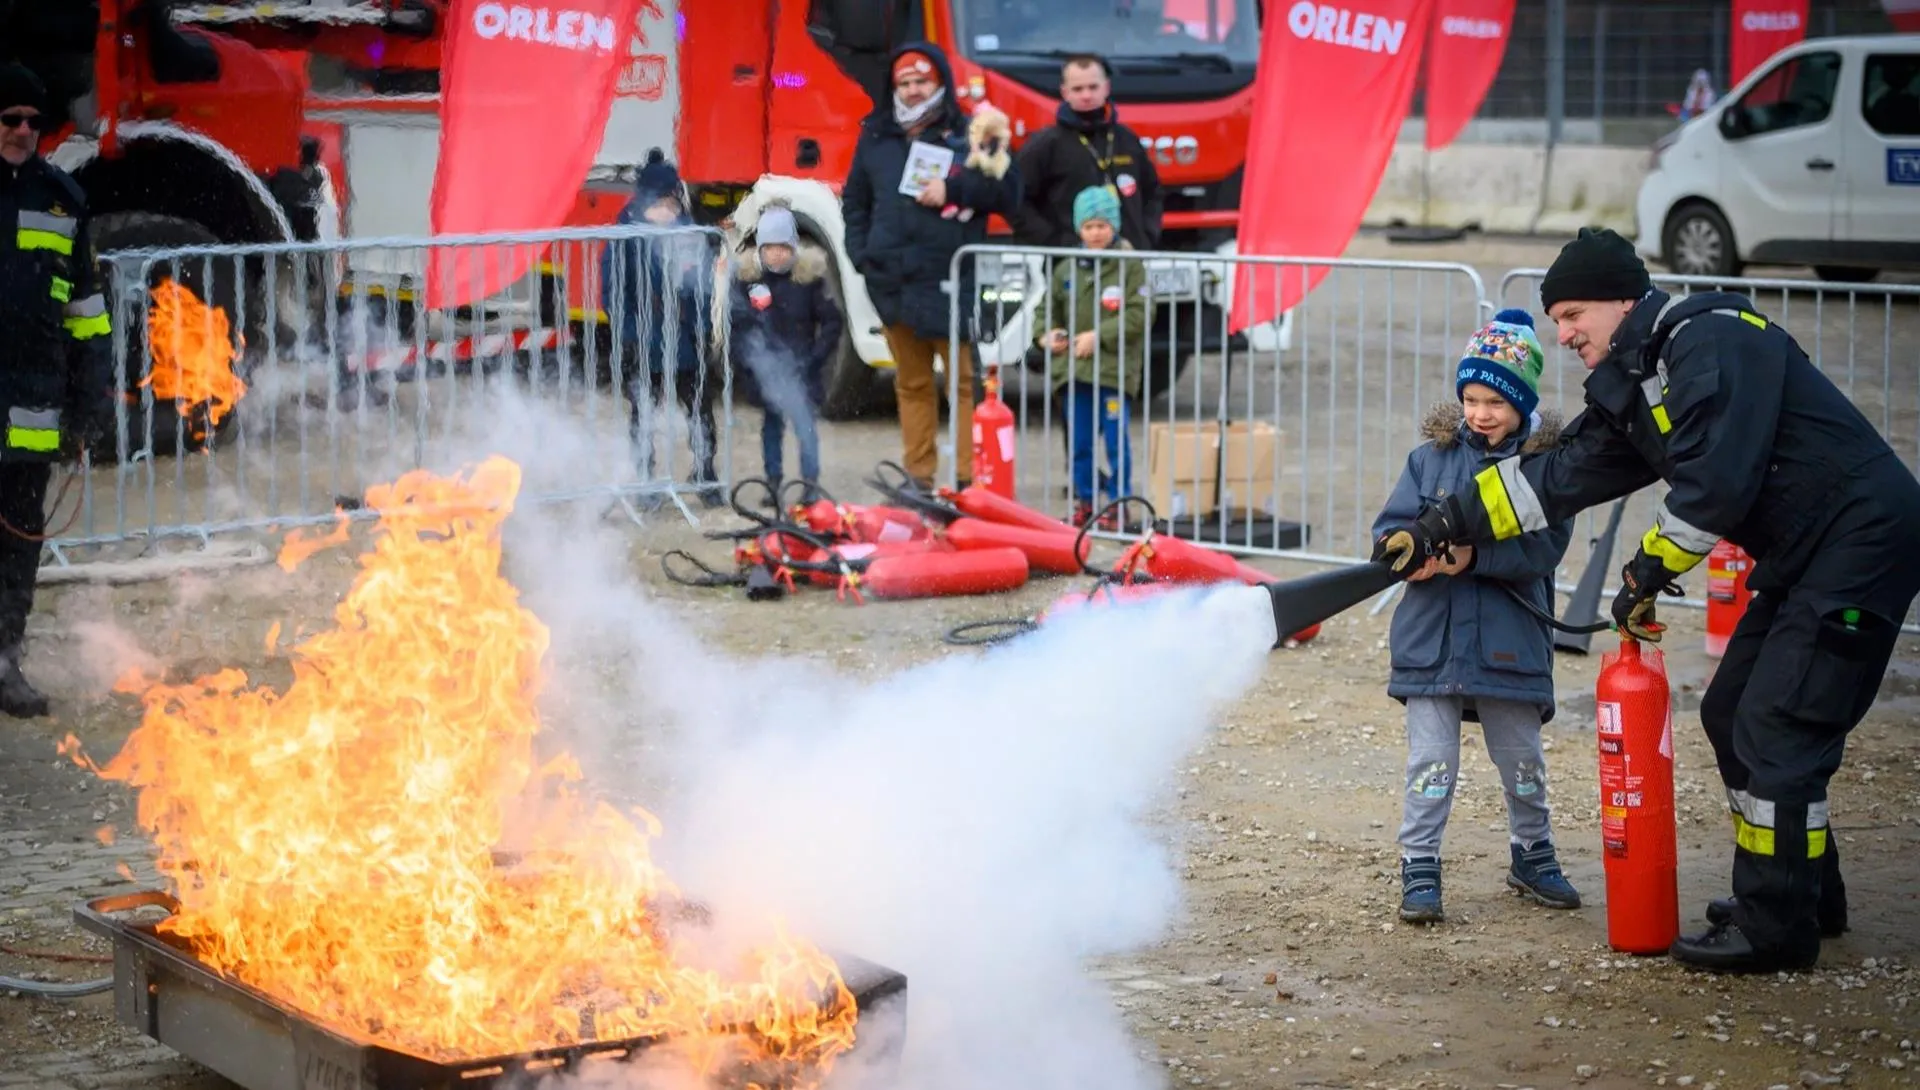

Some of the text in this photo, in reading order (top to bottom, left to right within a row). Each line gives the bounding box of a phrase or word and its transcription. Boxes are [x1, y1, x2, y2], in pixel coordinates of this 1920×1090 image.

[474, 4, 616, 50] ORLEN
[1287, 0, 1406, 55] ORLEN
[1442, 16, 1502, 38] ORLEN
[1742, 10, 1799, 32] ORLEN
[1459, 368, 1519, 398] PAW PATROL
